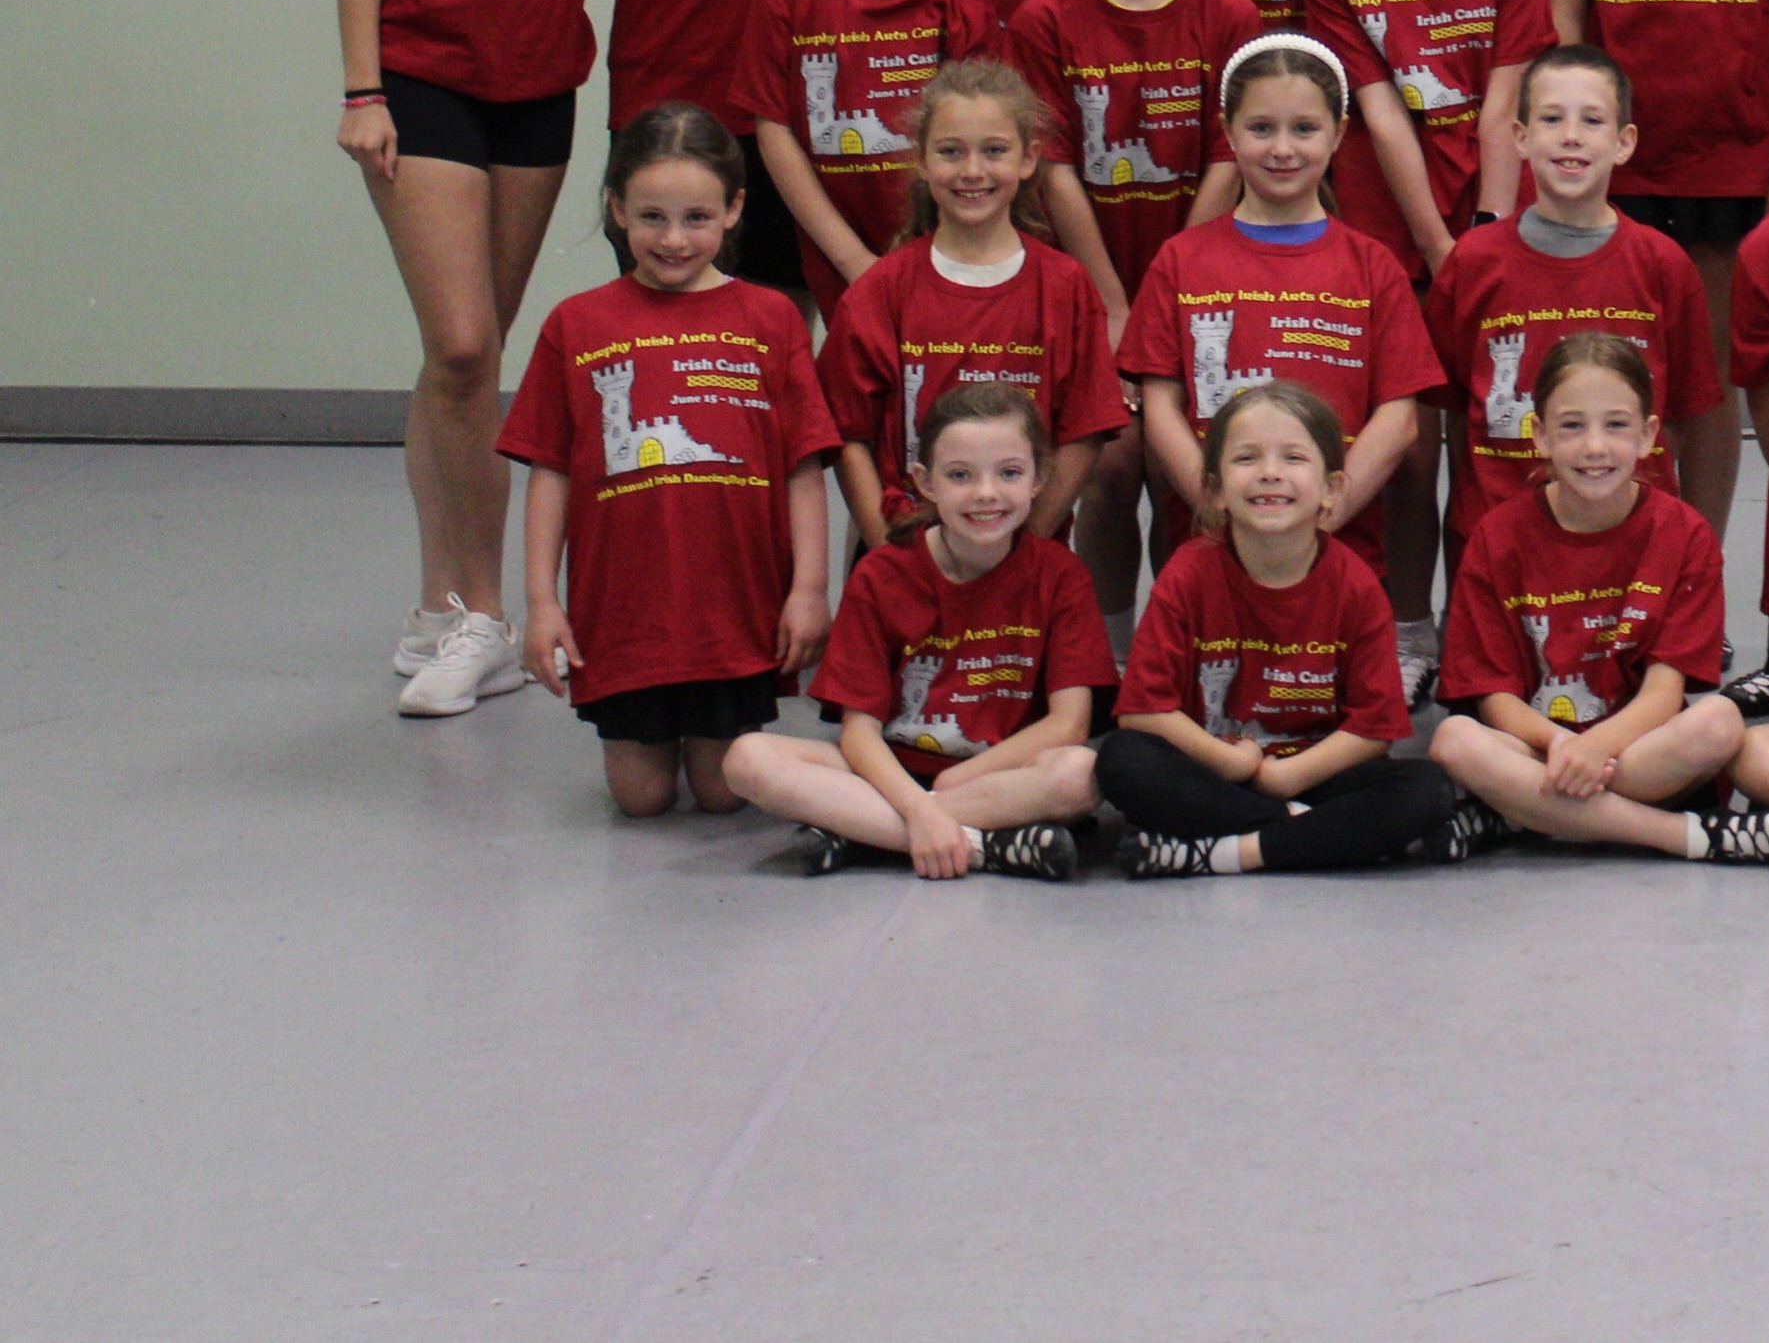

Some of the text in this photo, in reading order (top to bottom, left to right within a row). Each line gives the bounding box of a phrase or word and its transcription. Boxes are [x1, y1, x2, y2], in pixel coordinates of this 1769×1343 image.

[1177, 290, 1371, 308] Murphy Irish Arts Center
[1480, 307, 1656, 329] Murphy Irish Arts Center
[1270, 316, 1363, 336] Irish Castles
[635, 333, 716, 347] Irish Arts
[1264, 349, 1295, 358] June
[1297, 351, 1311, 360] 15
[672, 358, 713, 372] Irish
[670, 395, 700, 405] June
